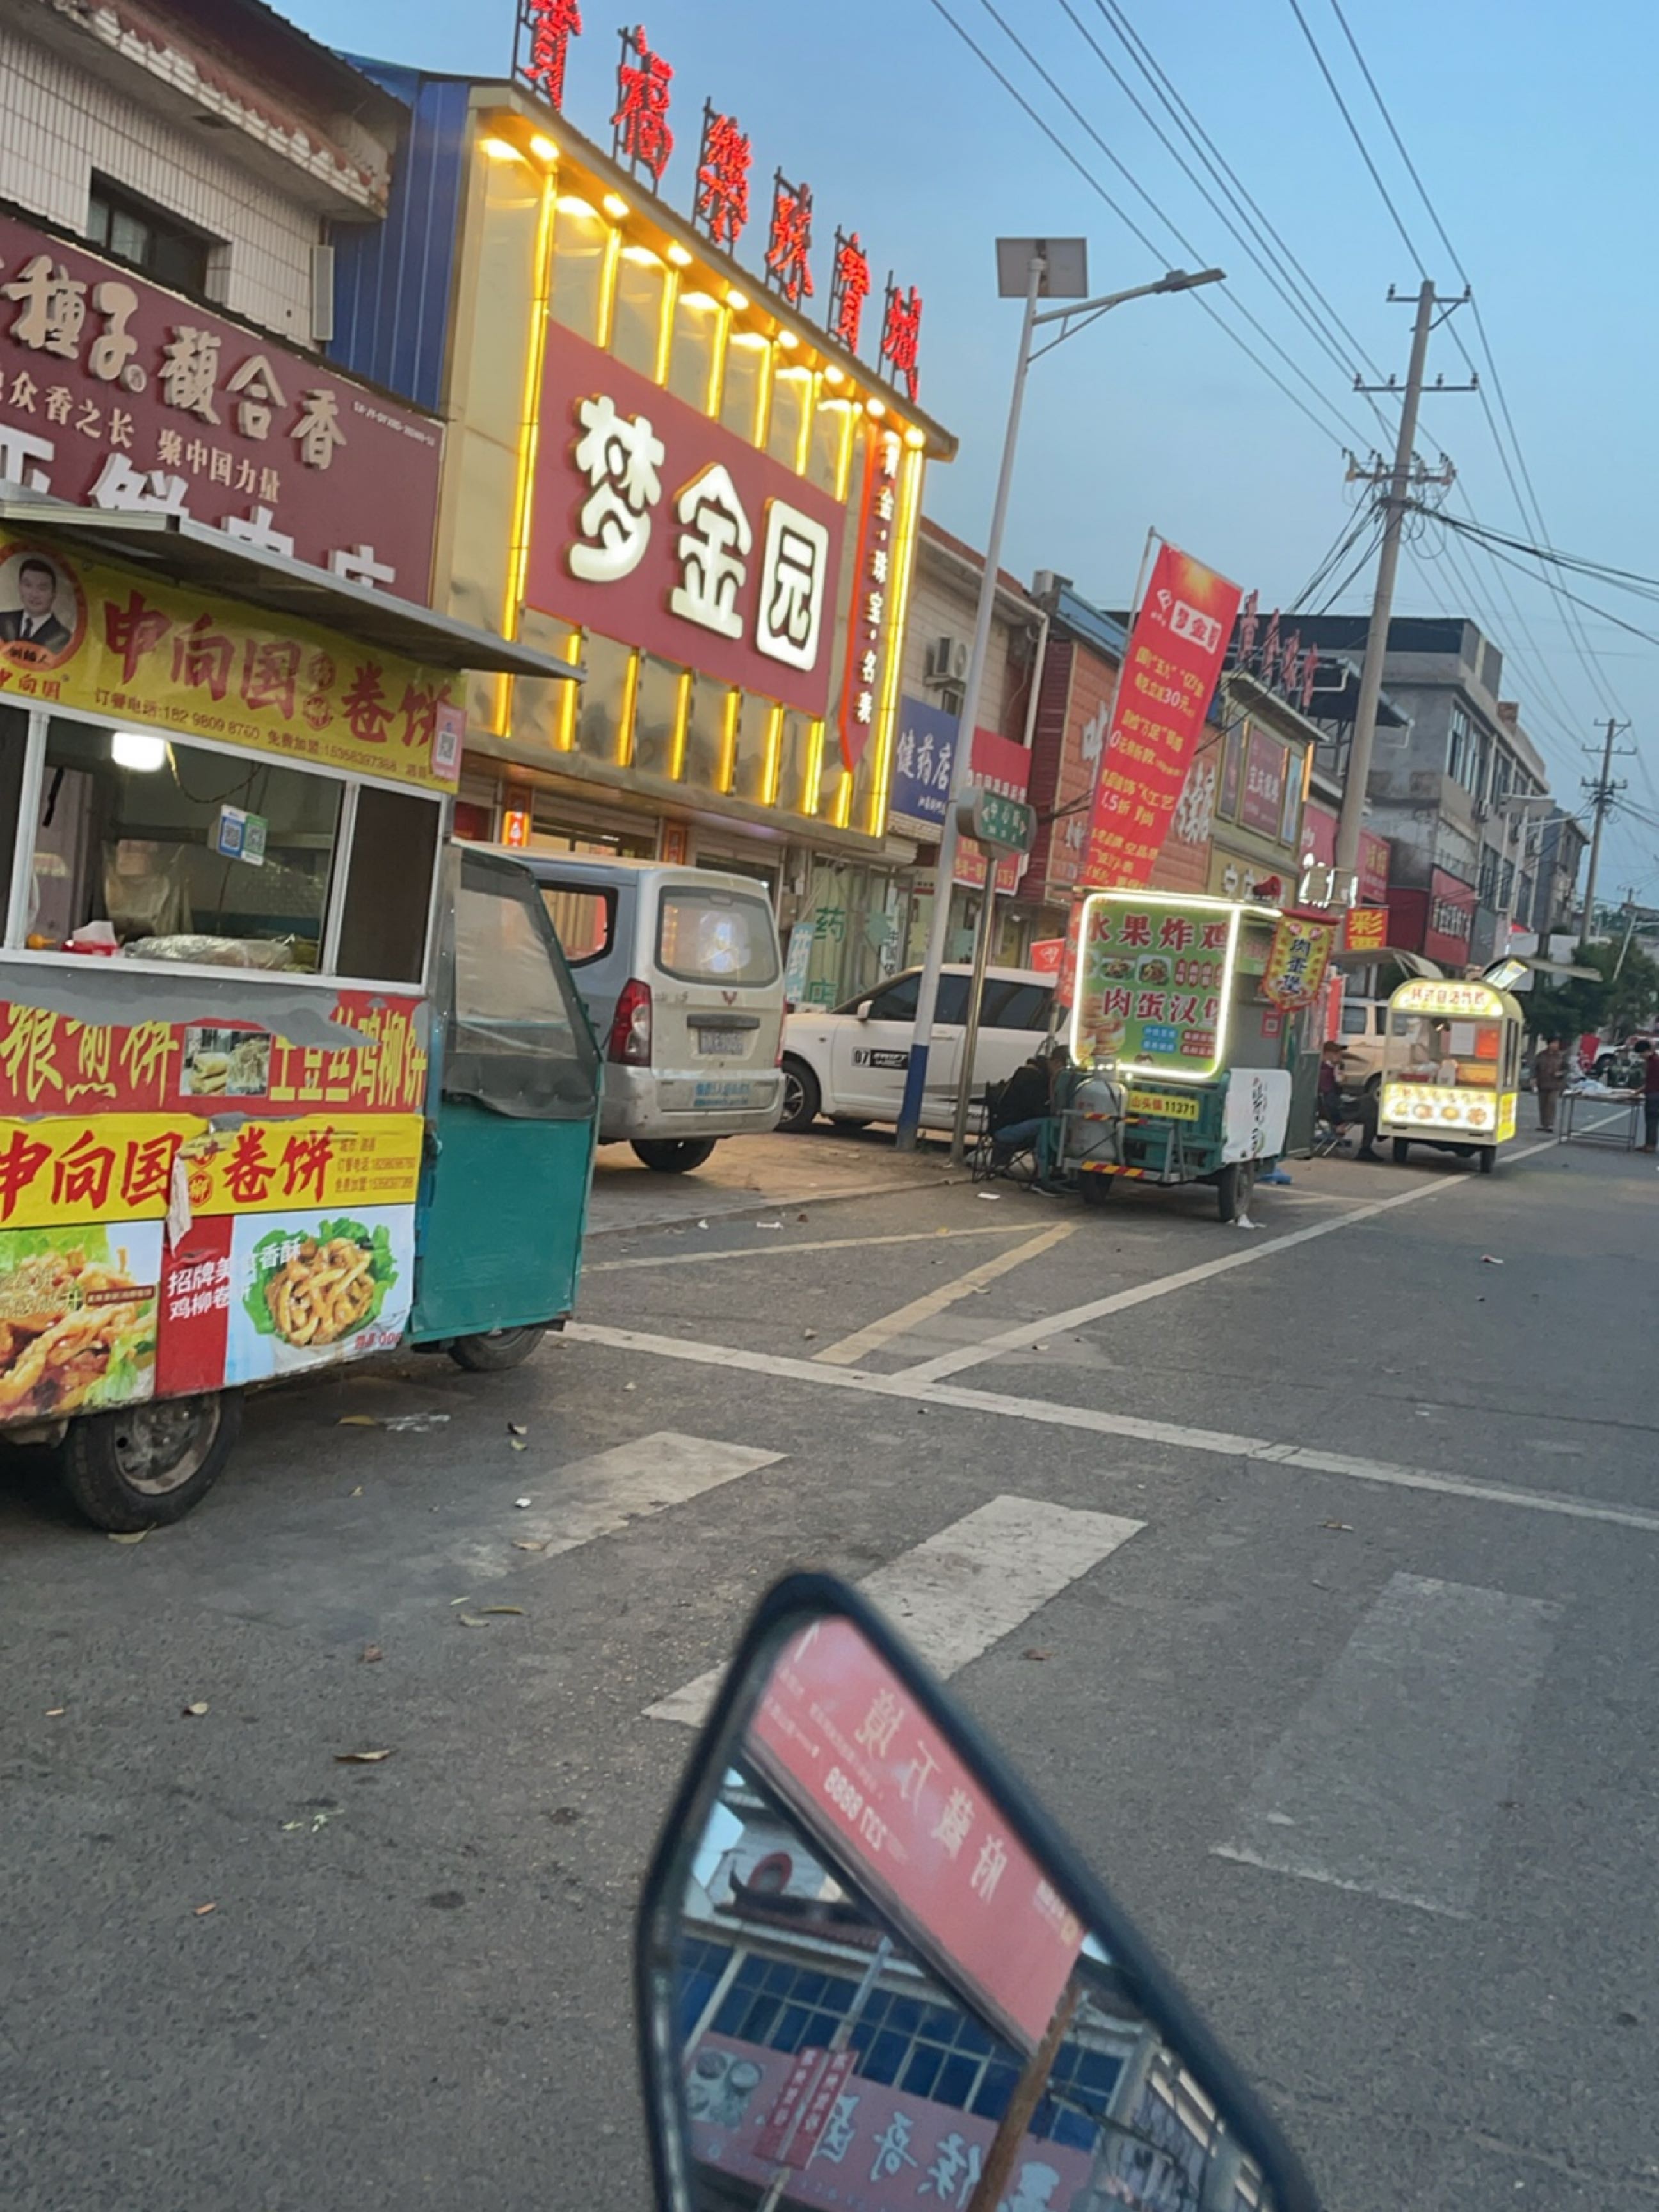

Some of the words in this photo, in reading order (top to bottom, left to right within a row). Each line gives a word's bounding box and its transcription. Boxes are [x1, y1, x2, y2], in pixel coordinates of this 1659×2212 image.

[0, 369, 134, 449] 众香之长
[157, 428, 282, 504] 聚中国力量
[158, 325, 347, 470] 馥合香
[566, 392, 830, 673] 梦金园
[102, 588, 302, 721] 申向国
[1089, 911, 1228, 952] 水果炸鸡
[854, 1050, 869, 1065] 07
[0, 1129, 183, 1216] 申向国
[221, 1125, 337, 1205] 卷饼
